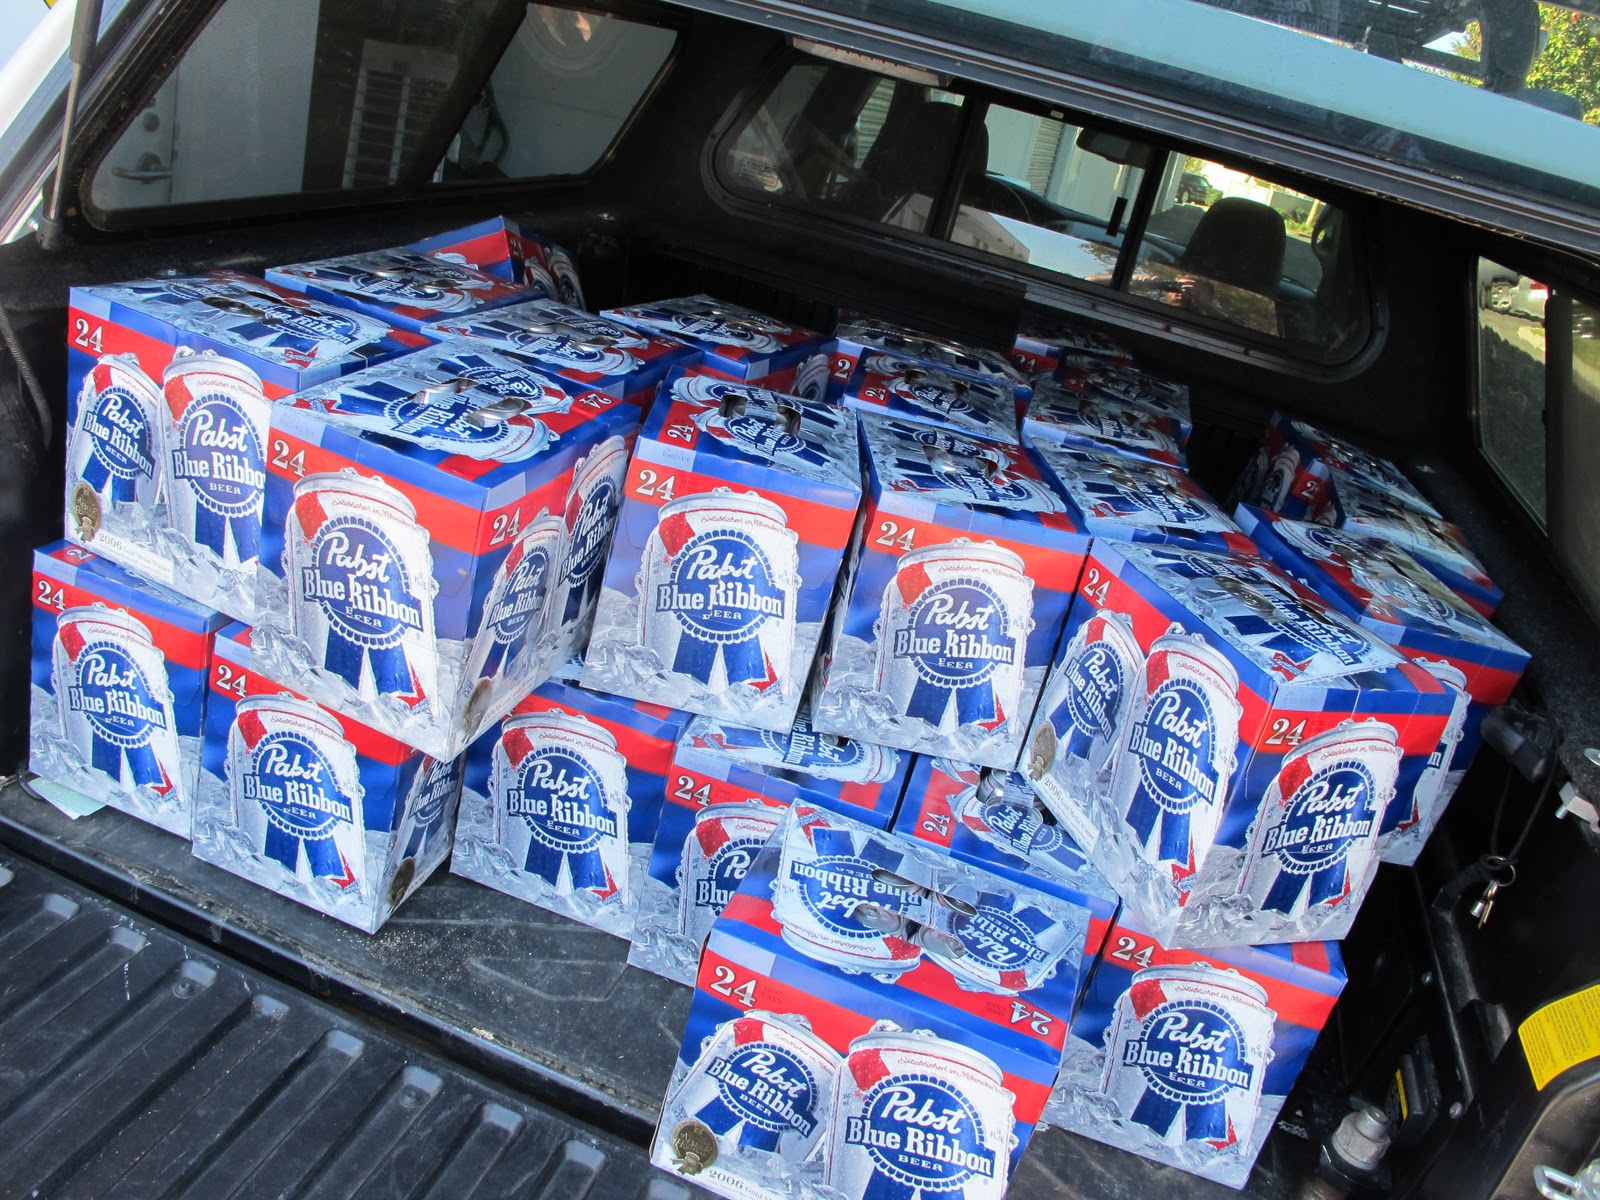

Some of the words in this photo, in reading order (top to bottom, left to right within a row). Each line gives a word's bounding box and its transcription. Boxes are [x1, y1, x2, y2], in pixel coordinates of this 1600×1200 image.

[75, 318, 103, 354] 24
[834, 359, 851, 378] 2
[101, 394, 144, 438] Pabst
[579, 391, 612, 409] 24
[189, 409, 248, 453] Pabst
[395, 407, 456, 433] Ribbon
[667, 423, 694, 443] 24
[732, 418, 767, 440] Pabst
[84, 413, 110, 442] Blue
[110, 424, 152, 477] Ribbon
[106, 444, 128, 465] BEER
[272, 438, 307, 477] 24
[174, 450, 208, 479] Blue
[211, 451, 265, 489] Ribbo
[635, 468, 676, 501] 24
[209, 482, 241, 495] BEER
[489, 506, 520, 546] 24
[577, 490, 611, 543] Pabst
[100, 533, 122, 550] 2006
[875, 521, 916, 552] 24
[324, 532, 390, 583] Pabst
[686, 545, 757, 581] Pabst
[510, 561, 544, 595] Pabst
[1083, 568, 1109, 606] 24
[38, 580, 66, 611] 24
[303, 567, 346, 601] Blue
[347, 574, 422, 629] Ribbon
[659, 584, 705, 611] Blue
[707, 580, 784, 617] Ribbon
[923, 594, 994, 629] Pabst
[346, 606, 383, 628] BEER
[490, 602, 513, 625] Blue
[702, 609, 742, 622] BEER
[896, 629, 940, 655] Blue
[943, 629, 1014, 662] Ribbon
[1300, 619, 1354, 665] Ribbon
[86, 654, 137, 690] Pabst
[938, 657, 973, 670] BEER
[1084, 648, 1117, 700] Pabst
[215, 664, 250, 698] 24
[70, 687, 105, 713] Blue
[107, 688, 165, 728] Ribbon
[1066, 659, 1086, 694] Blue
[1083, 679, 1113, 738] Ribbon
[1076, 695, 1094, 720] BEER
[105, 715, 135, 728] BEER
[1160, 691, 1206, 748] Pabst
[1265, 717, 1308, 746] 24
[264, 743, 324, 782] Pabst
[1131, 727, 1163, 761] Blue
[1162, 740, 1216, 801] Ribbon
[1156, 767, 1182, 792] BEER
[531, 760, 591, 800] Pabst
[674, 775, 711, 807] 24
[1044, 778, 1062, 800] 2006
[244, 773, 284, 801] Blue
[286, 779, 351, 822] Ribbon
[283, 805, 317, 820] BEER
[508, 790, 549, 815] Blue
[550, 793, 616, 836] Ribbon
[1297, 779, 1366, 817] Pabst
[547, 819, 580, 837] BEER
[922, 811, 951, 837] 24
[988, 805, 1023, 834] Pabst
[1265, 822, 1310, 853] Blue
[1310, 816, 1372, 845] Ribbon
[1012, 830, 1032, 855] Blue
[1301, 842, 1334, 855] BEER
[793, 862, 869, 897] Ribbon
[958, 924, 1018, 966] Pabst
[1009, 936, 1049, 962] Blue
[1112, 936, 1156, 968] 24
[709, 965, 757, 1008] 24
[1009, 1000, 1053, 1036] 24
[1157, 1012, 1231, 1052] Pabst
[742, 1052, 809, 1099] Pabst
[898, 1056, 947, 1071] Established
[1125, 1041, 1174, 1068] Blue
[1175, 1047, 1250, 1088] Ribbon
[1168, 1071, 1206, 1088] BEER
[707, 1060, 745, 1090] Blue
[747, 1077, 812, 1137] Ribbon
[740, 1093, 773, 1117] BEER
[880, 1086, 967, 1136] Pabst
[847, 1121, 901, 1151] Blue
[903, 1126, 994, 1178] Ribbon
[897, 1153, 944, 1173] BEER
[708, 1168, 744, 1191] 2006
[745, 1185, 764, 1199] Gold
